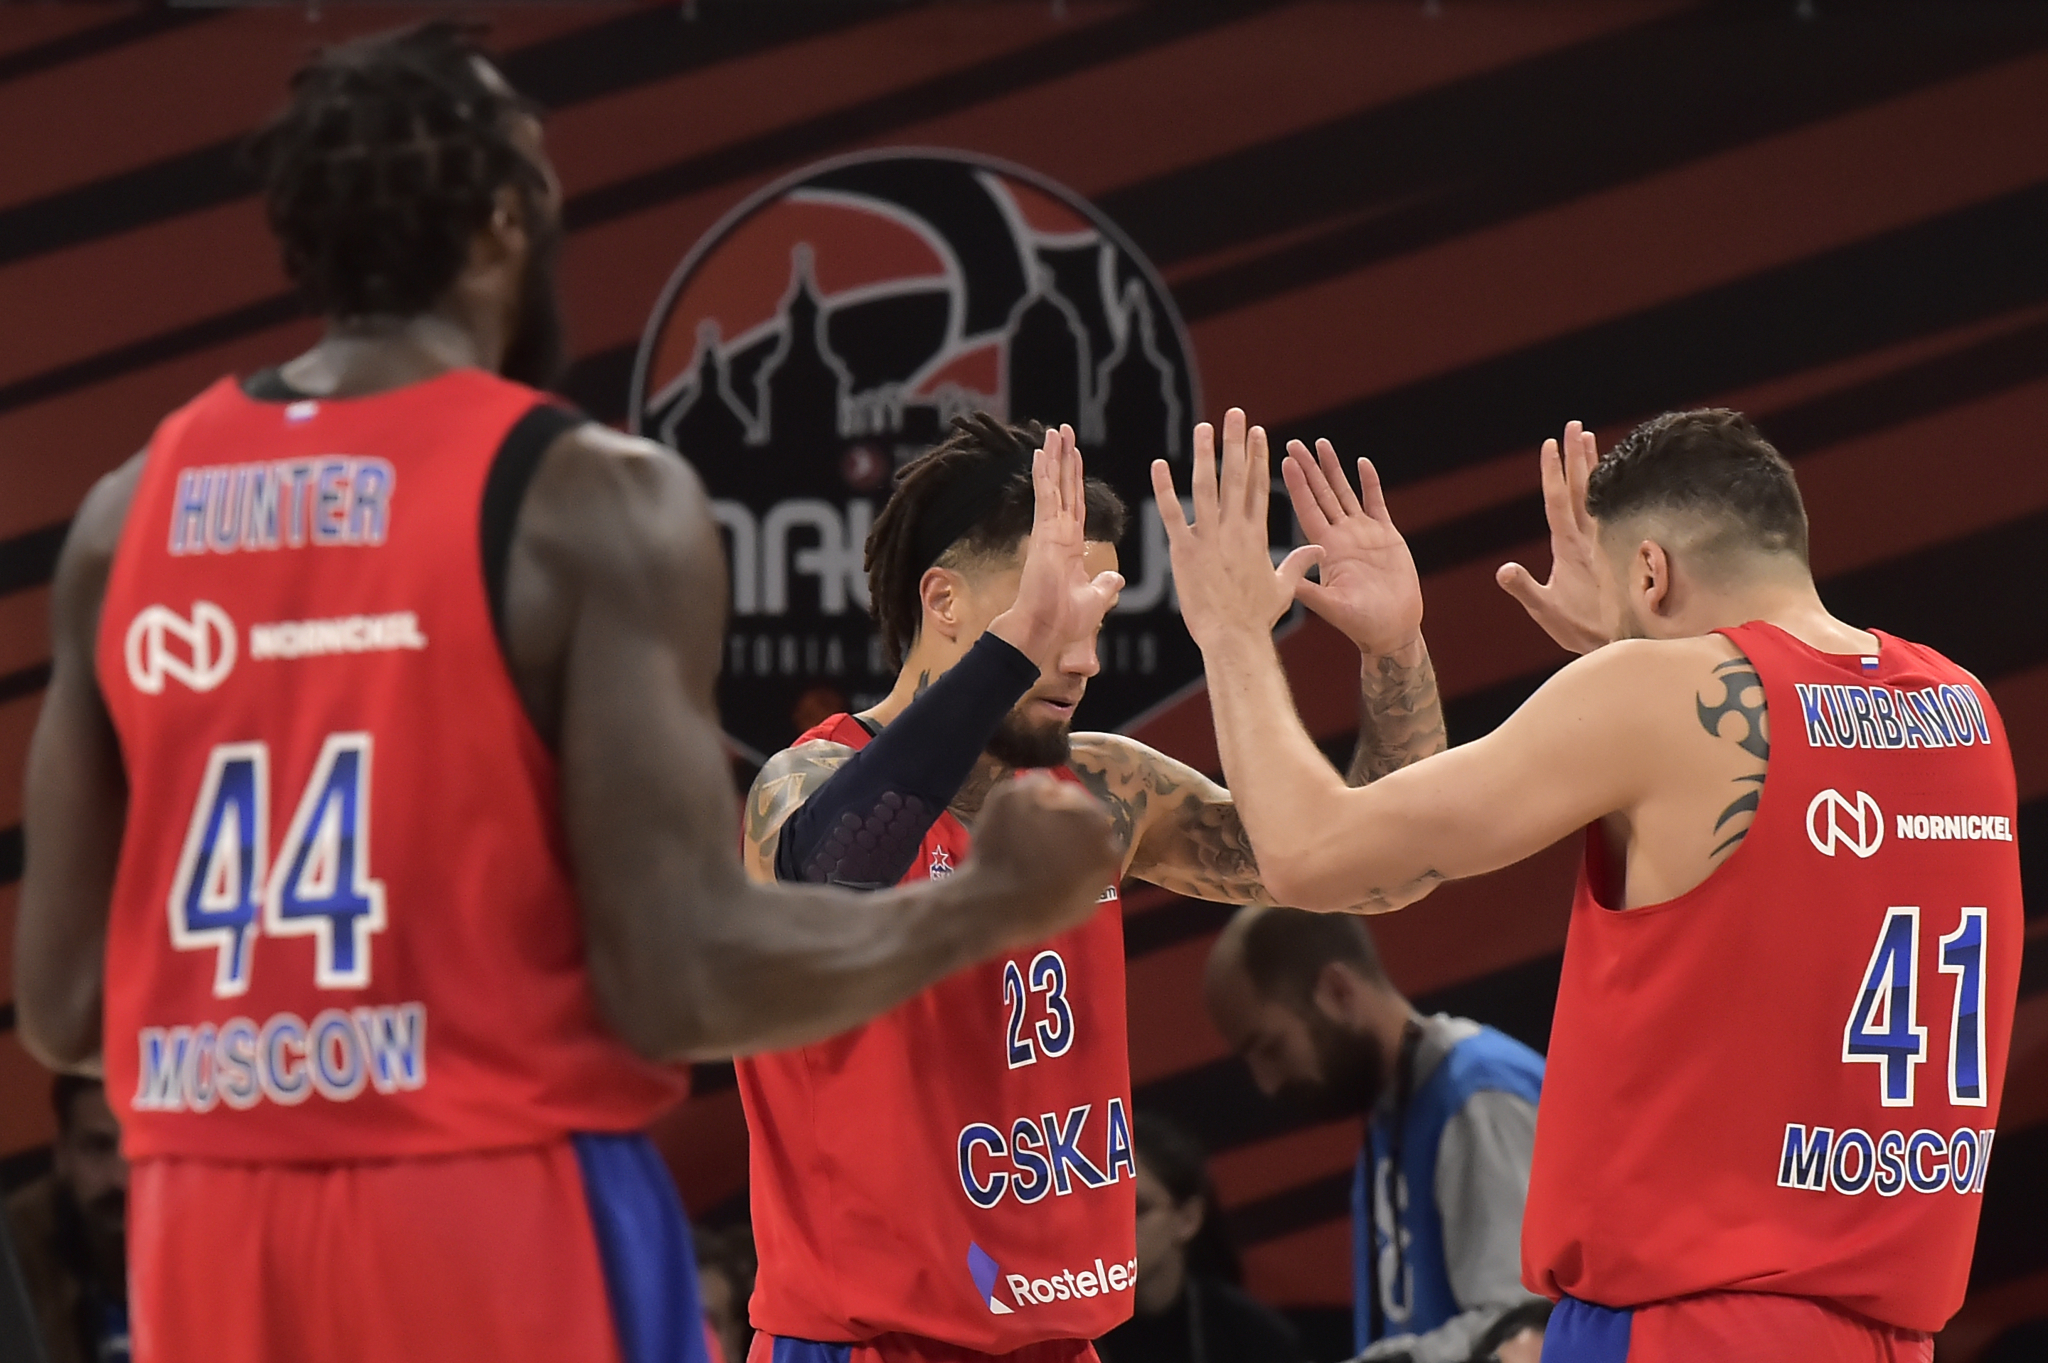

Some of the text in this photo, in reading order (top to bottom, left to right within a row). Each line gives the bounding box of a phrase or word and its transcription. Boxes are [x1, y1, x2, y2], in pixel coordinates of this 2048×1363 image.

[168, 454, 397, 557] HUNTER
[251, 611, 428, 661] NORNICKEL
[1794, 683, 1991, 749] KURBANOV
[169, 731, 386, 997] 44
[1896, 815, 2013, 841] NORNICKEL
[131, 1001, 427, 1113] MOSCOW
[1003, 951, 1075, 1069] 23
[1841, 906, 1988, 1107] 41
[957, 1098, 1136, 1209] CSKA
